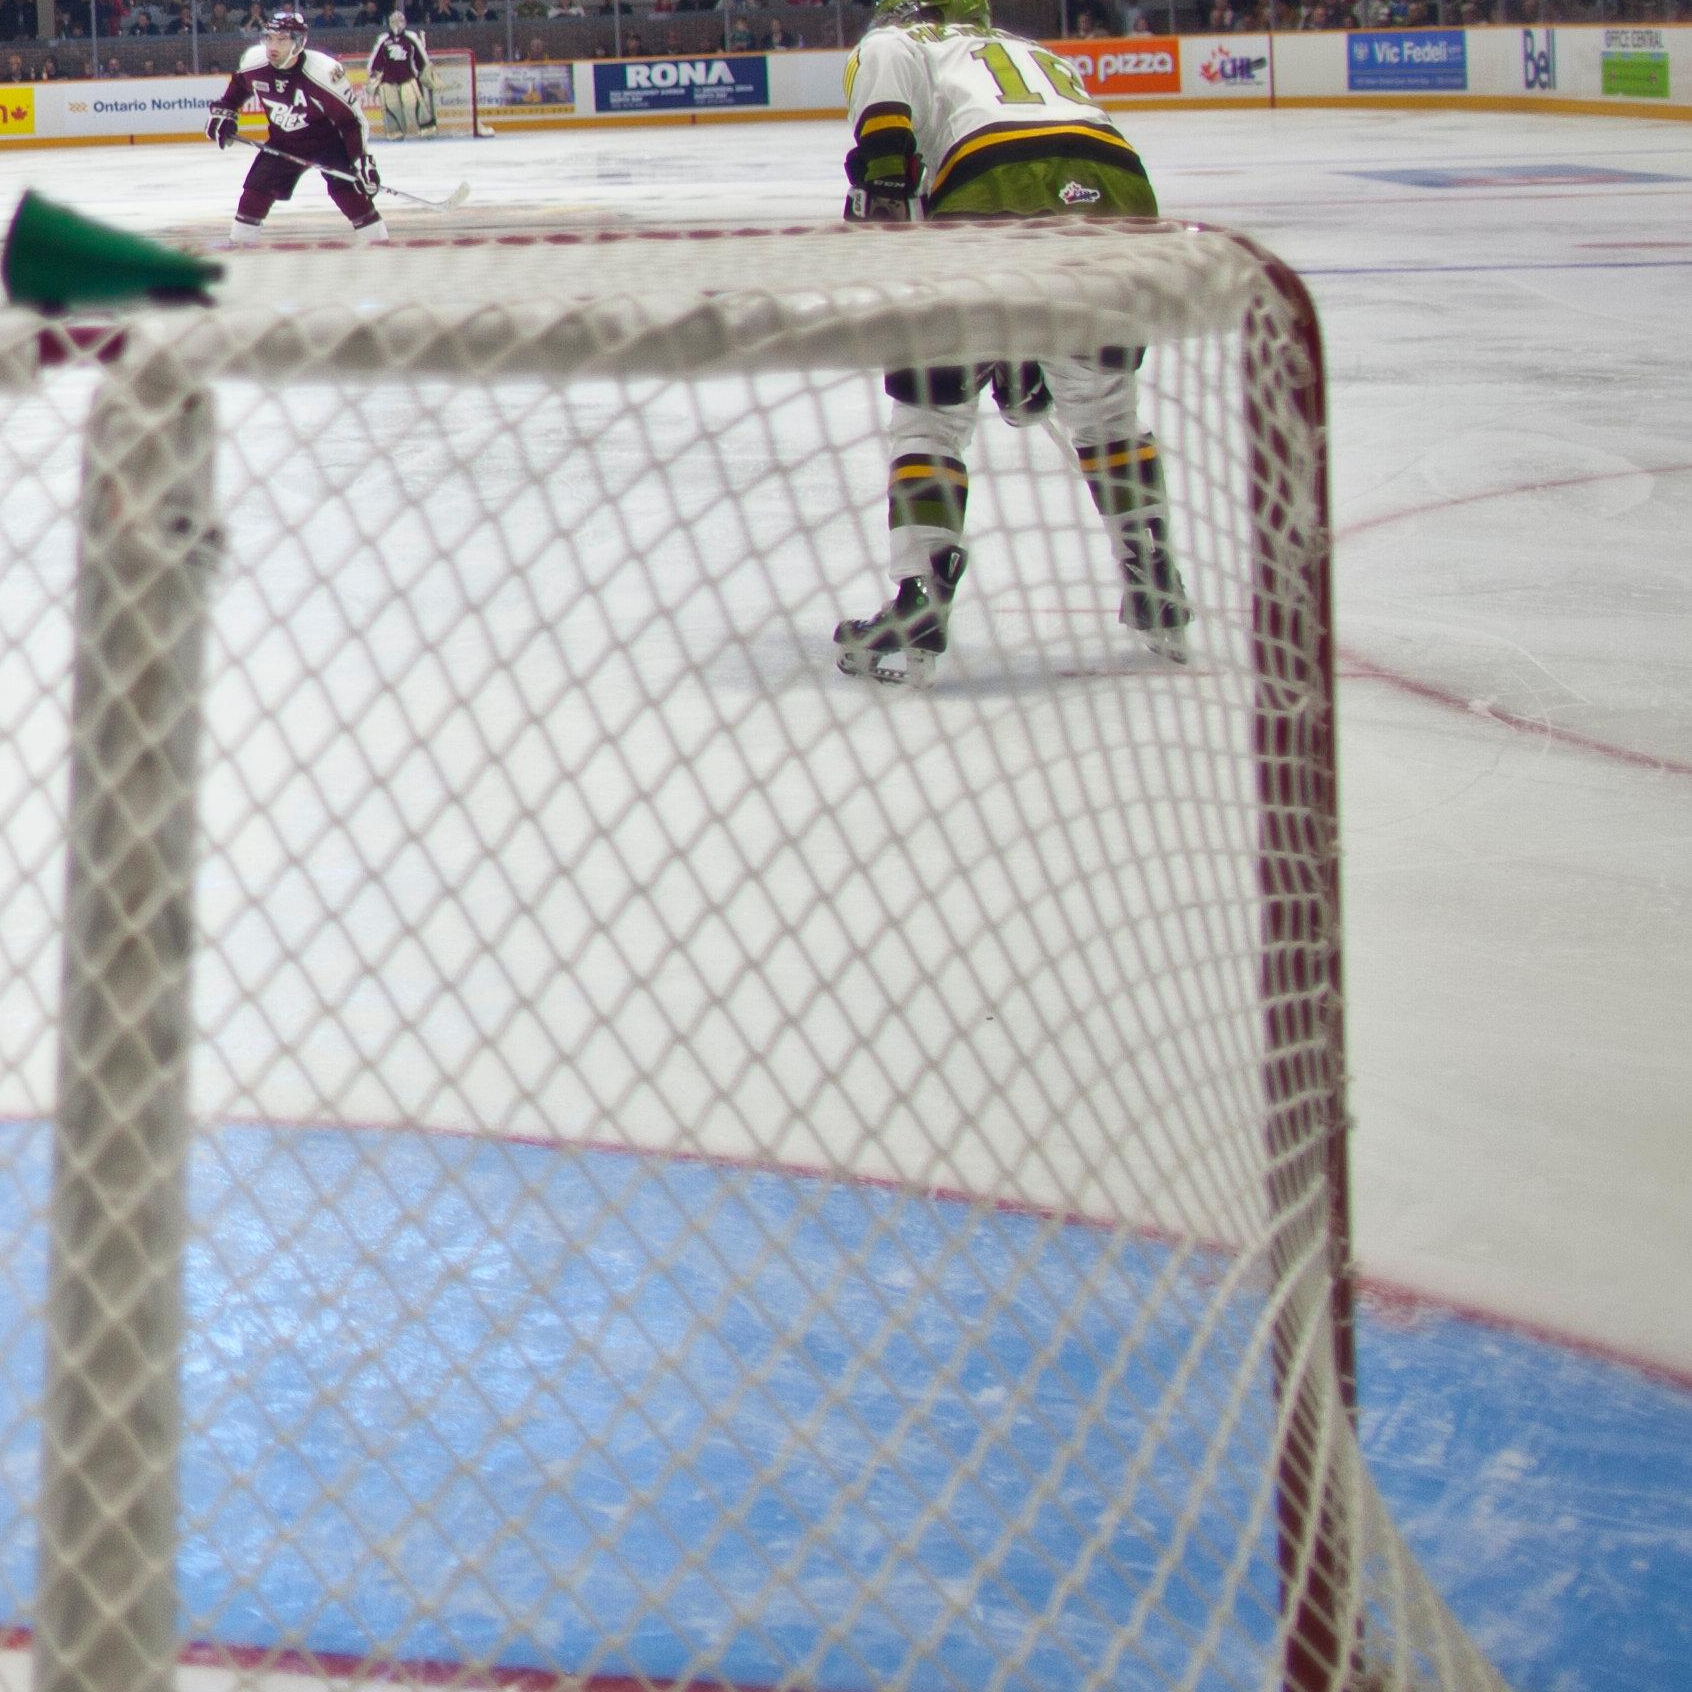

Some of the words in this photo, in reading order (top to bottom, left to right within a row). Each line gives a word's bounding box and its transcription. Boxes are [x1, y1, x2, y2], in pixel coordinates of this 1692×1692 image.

[1374, 42, 1400, 63] Vic
[1403, 40, 1448, 63] Fedeli
[1522, 28, 1556, 90] Bell
[626, 60, 736, 90] RONA
[1098, 52, 1173, 83] pizza
[93, 98, 147, 114] Ontario
[293, 88, 308, 108] A
